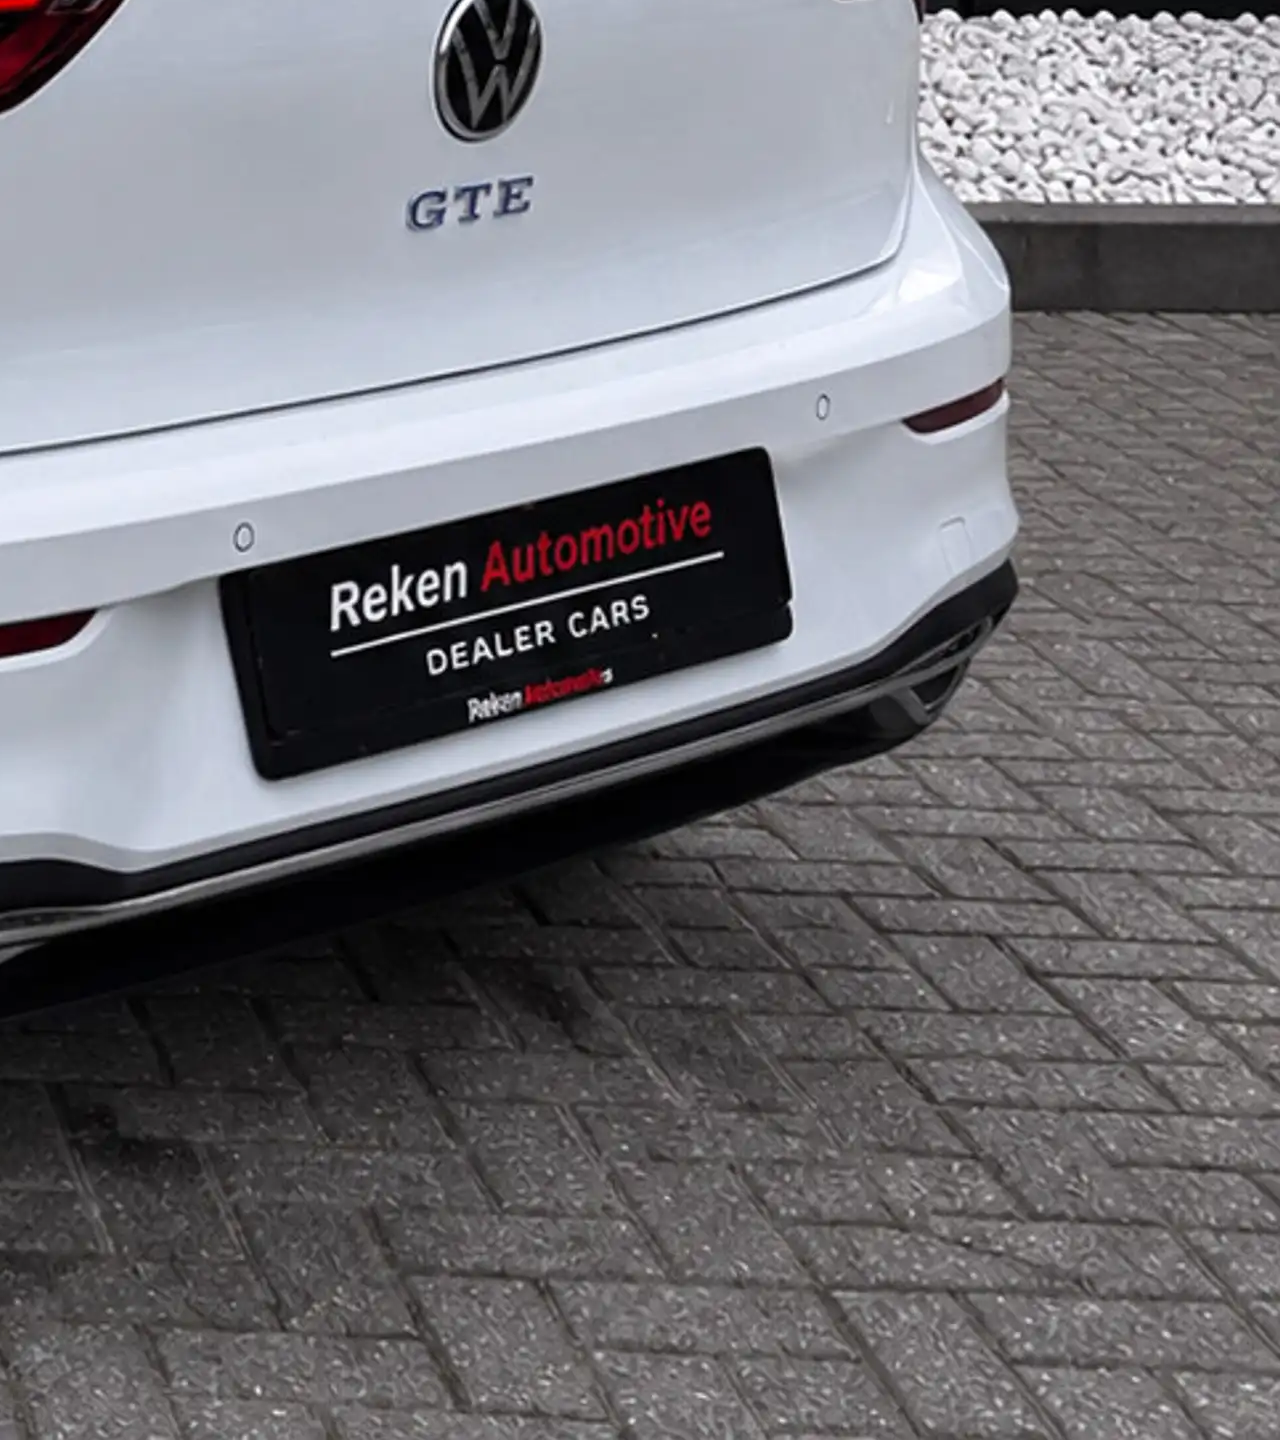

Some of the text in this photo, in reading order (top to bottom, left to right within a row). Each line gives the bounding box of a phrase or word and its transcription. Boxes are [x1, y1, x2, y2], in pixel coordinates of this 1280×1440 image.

[407, 176, 534, 231] GTE
[329, 498, 712, 632] Reken Automotive
[425, 594, 651, 676] DEALER CARS
